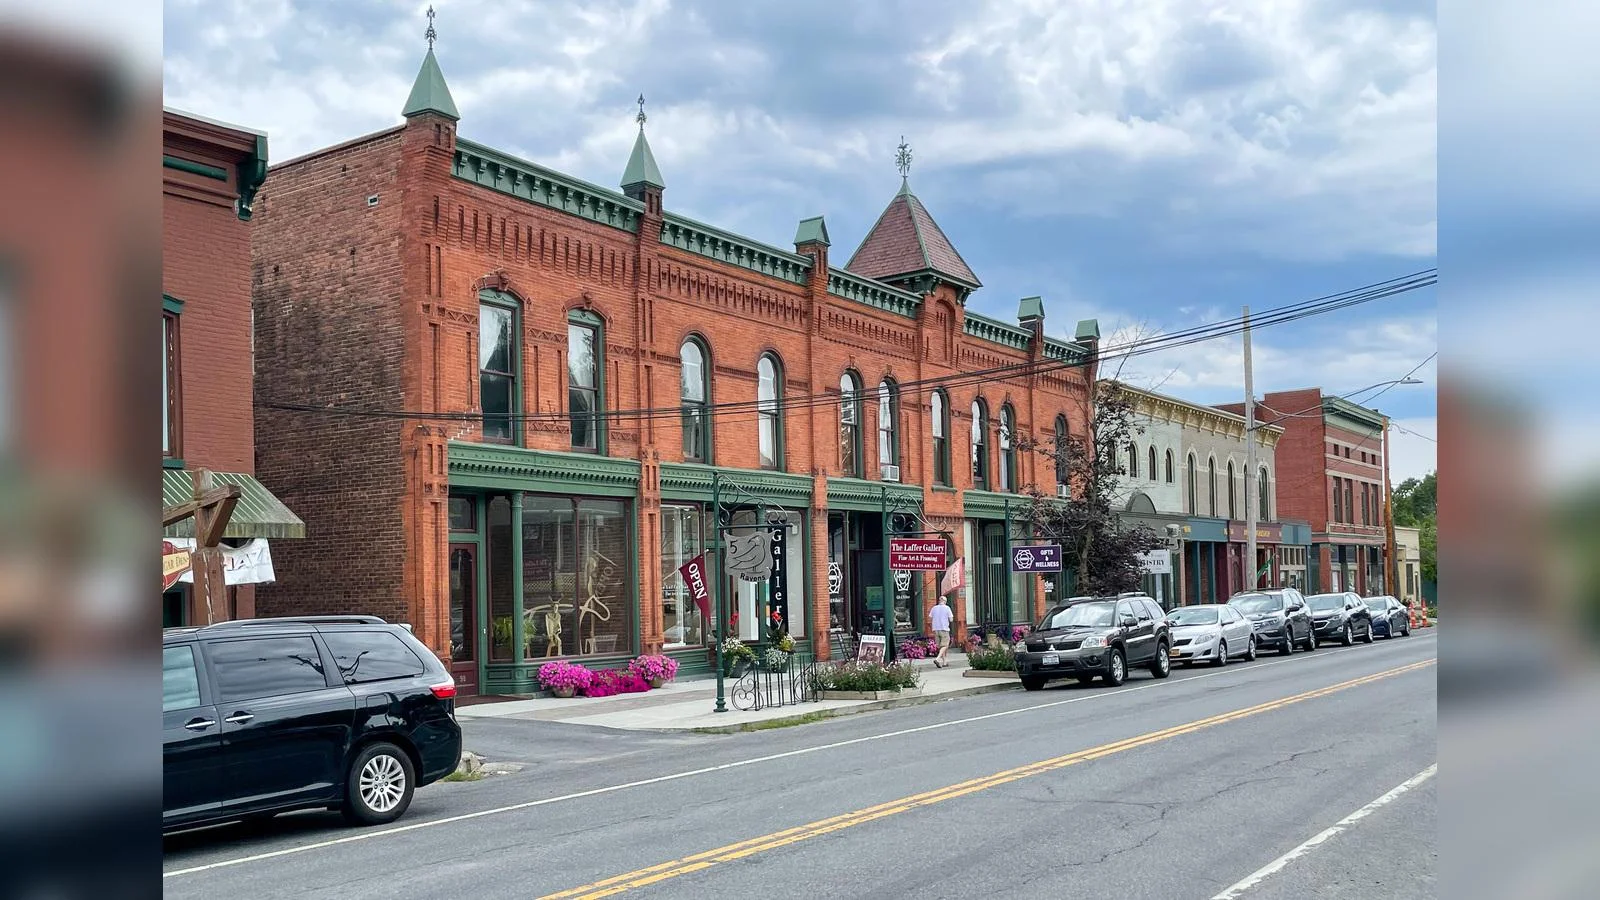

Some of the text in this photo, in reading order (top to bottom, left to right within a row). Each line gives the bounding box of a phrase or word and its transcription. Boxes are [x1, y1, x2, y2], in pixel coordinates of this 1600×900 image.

[730, 541, 738, 554] 5
[891, 543, 945, 555] The Laffer Gallery
[689, 563, 707, 599] OPEN
[740, 573, 766, 581] Ravens
